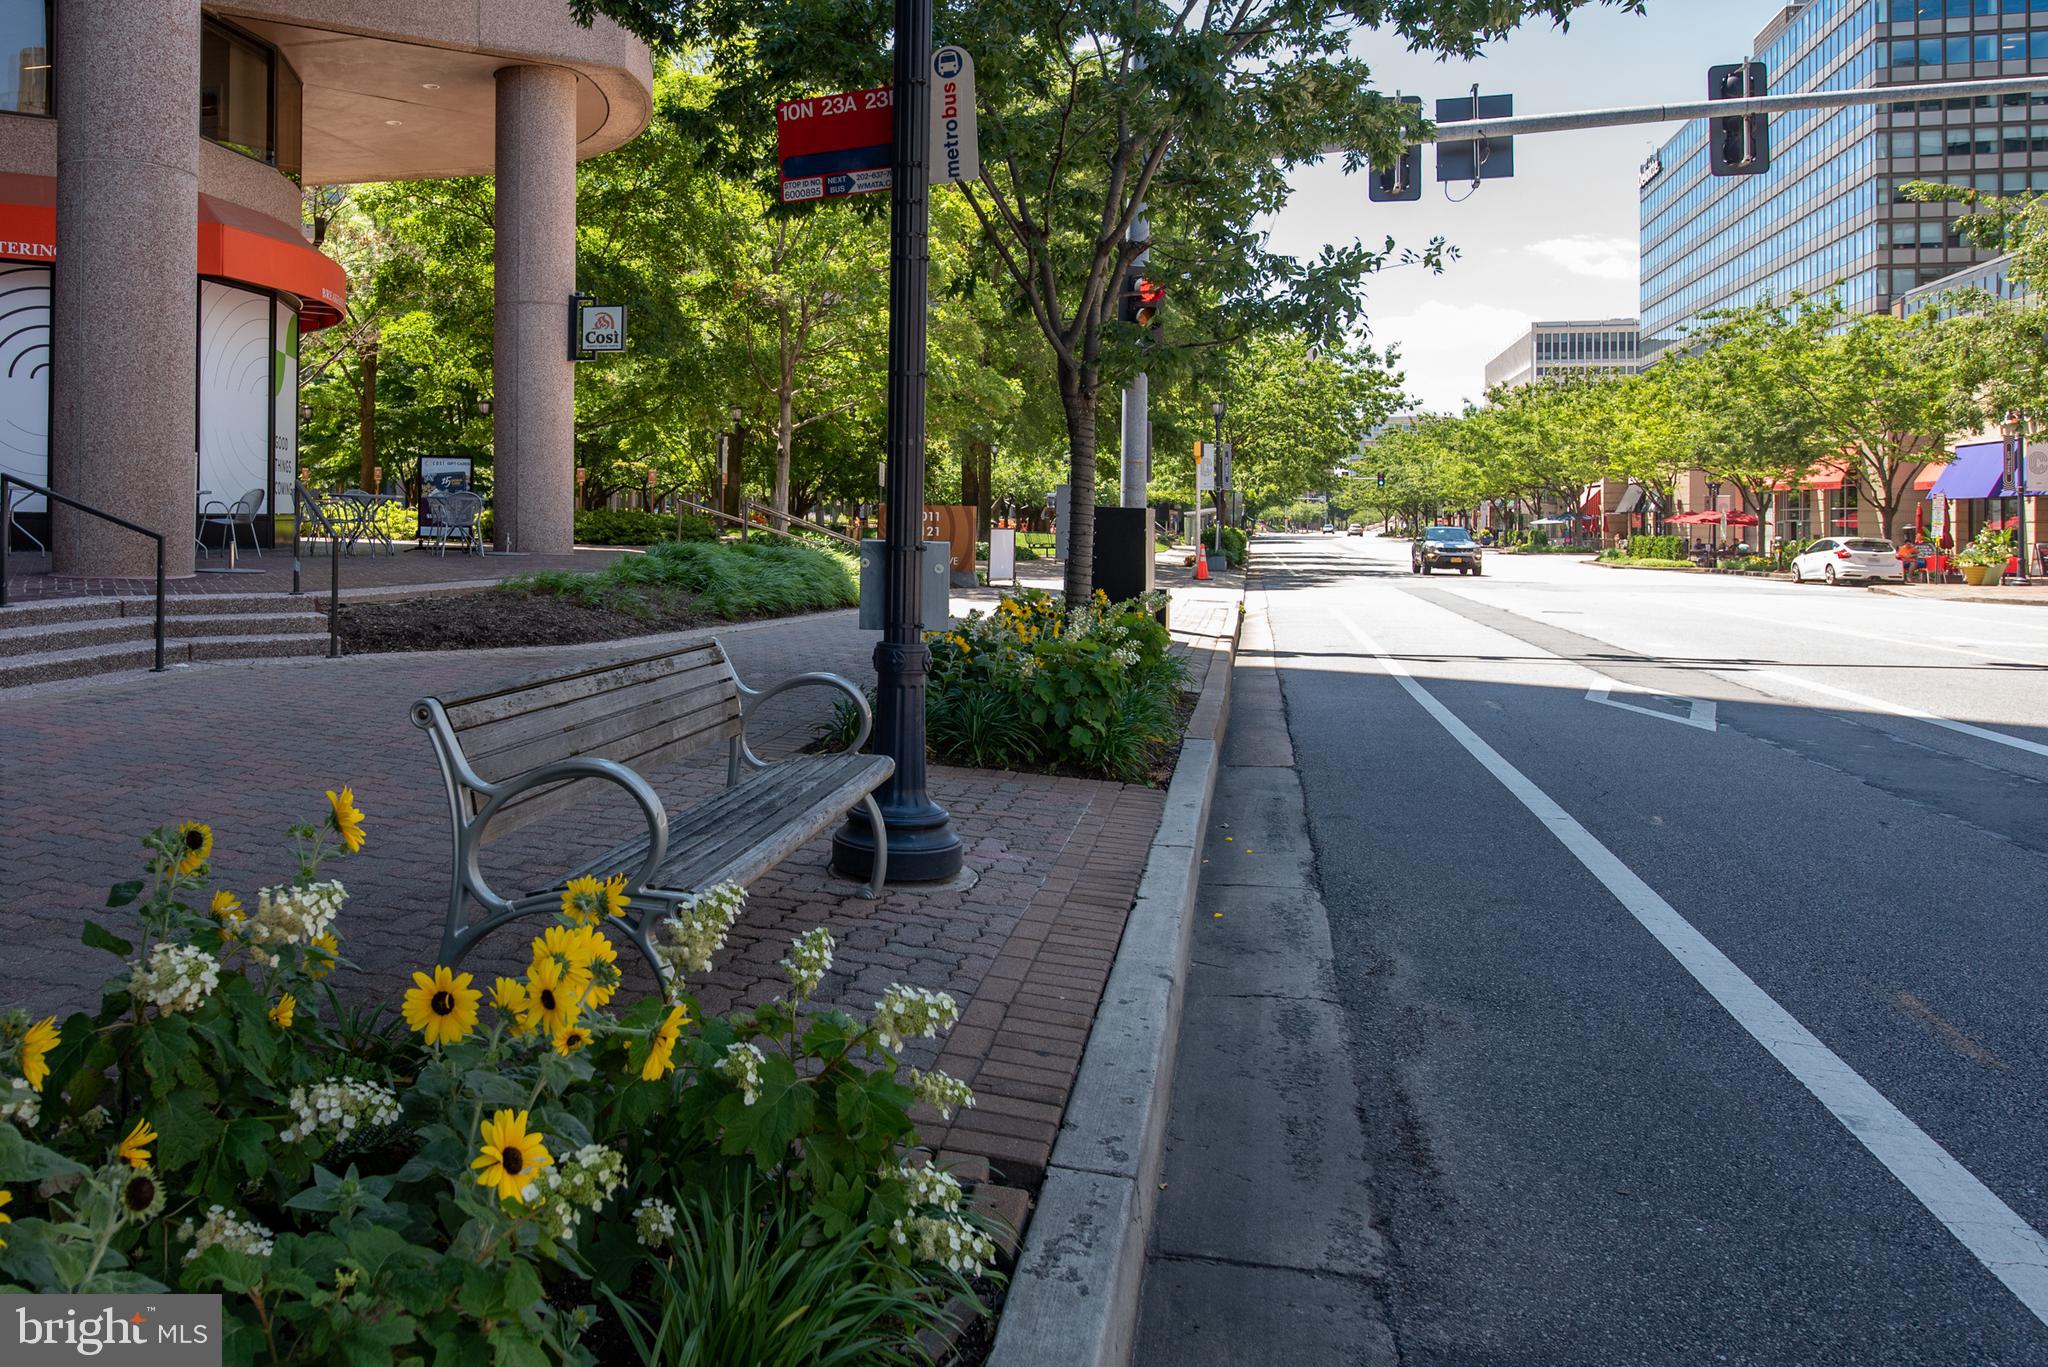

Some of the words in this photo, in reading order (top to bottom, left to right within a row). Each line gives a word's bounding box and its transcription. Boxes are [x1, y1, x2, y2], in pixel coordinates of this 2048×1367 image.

[780, 101, 814, 122] 10N
[821, 95, 857, 116] 23A
[942, 81, 960, 179] metrobus
[784, 181, 801, 190] STOP
[802, 180, 809, 188] ID
[827, 175, 847, 184] NEXT
[784, 187, 821, 200] 6000895
[830, 185, 846, 194] BUS
